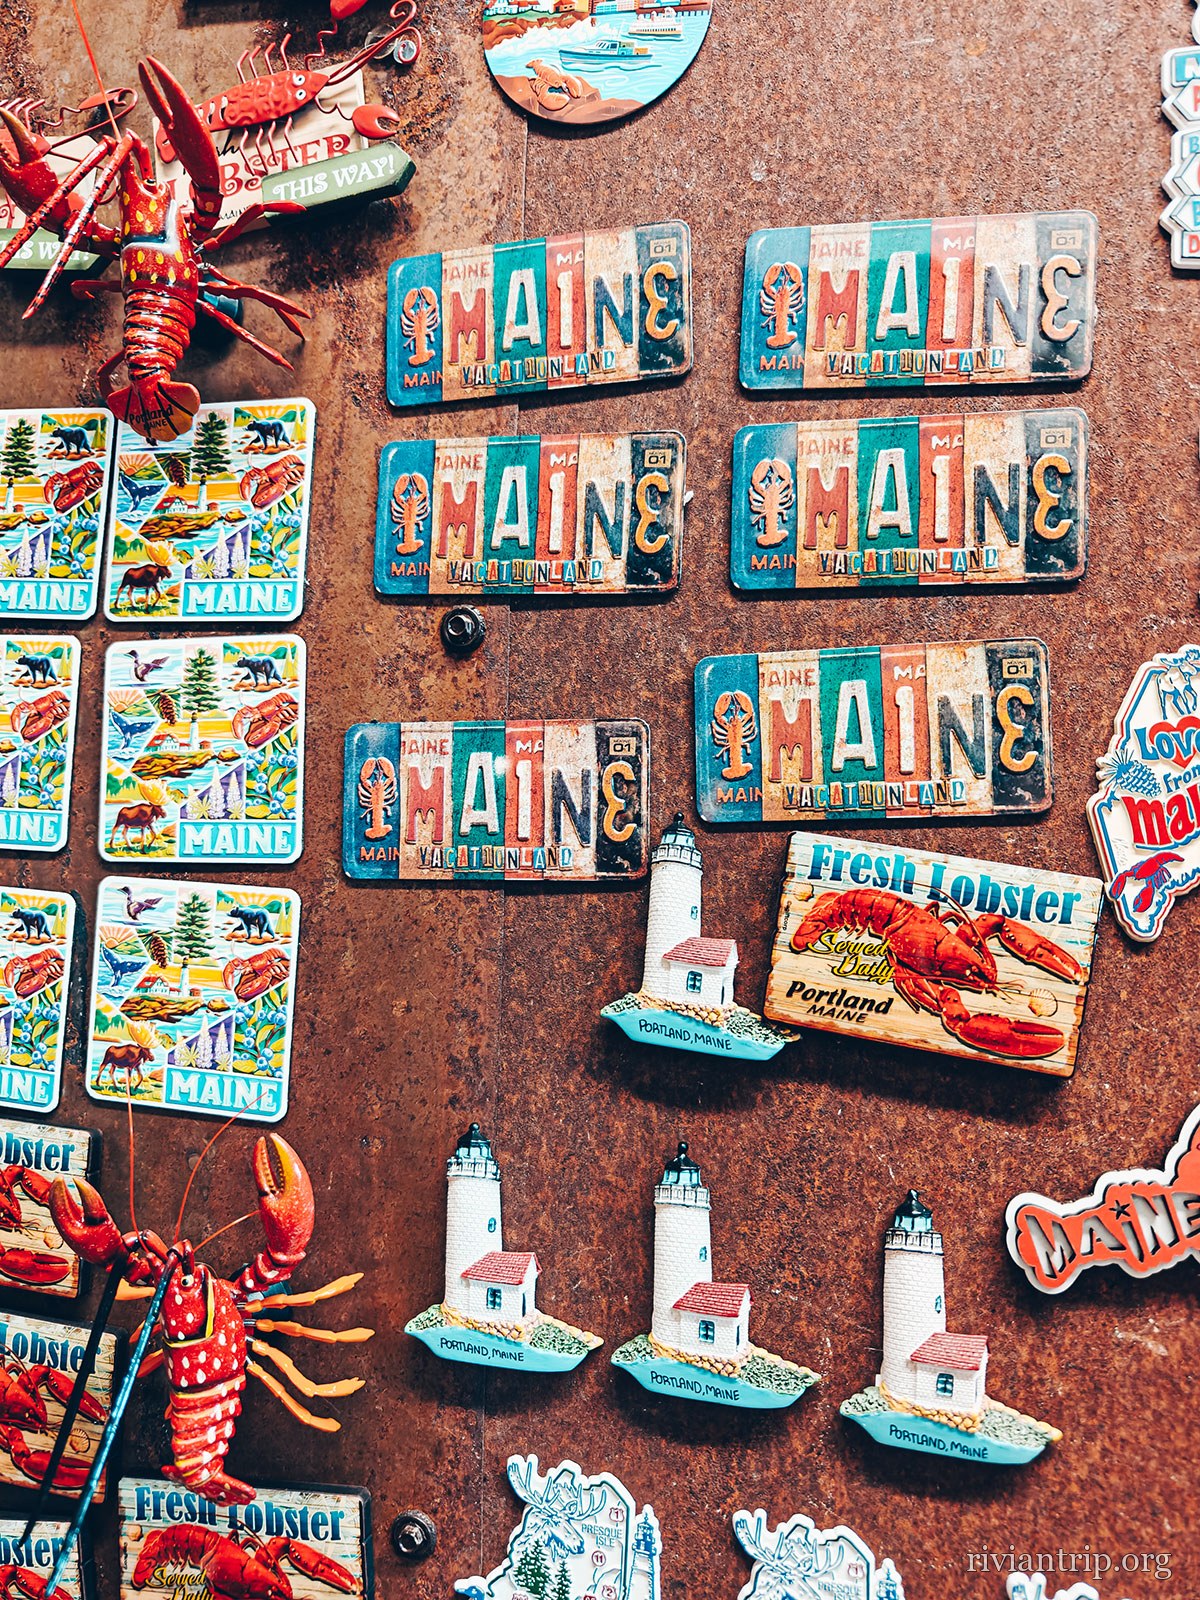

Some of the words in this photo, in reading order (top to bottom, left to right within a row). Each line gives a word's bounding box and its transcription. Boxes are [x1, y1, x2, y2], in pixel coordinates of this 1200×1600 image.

[272, 174, 329, 201] THIS
[331, 153, 395, 189] WAY!
[653, 244, 671, 254] 01
[1056, 236, 1076, 245] 01
[1045, 434, 1065, 444] 01
[648, 455, 666, 464] 01
[0, 581, 90, 611] MAINE
[186, 582, 294, 613] MAINE
[1007, 665, 1027, 675] 01
[613, 743, 631, 752] 01
[0, 811, 59, 843] AINE
[182, 823, 293, 855] MAINE
[807, 844, 917, 896] Fresh
[924, 862, 1082, 924] Lobster
[807, 931, 891, 957] Served
[832, 954, 896, 985] Daily
[785, 980, 894, 1015] Portland
[806, 1004, 868, 1023] MAINE
[694, 1032, 732, 1051] MAINE
[0, 1069, 51, 1104] INE
[170, 1070, 279, 1114] MAINE
[0, 1131, 76, 1172] bster
[1025, 1191, 1200, 1279] MAINE
[491, 1348, 524, 1362] MAINE
[706, 1385, 740, 1401] MAINE
[950, 1440, 988, 1459] MAINE
[581, 1523, 623, 1539] PRESQUE
[595, 1536, 615, 1547] ISLE
[145, 1567, 207, 1589] Served
